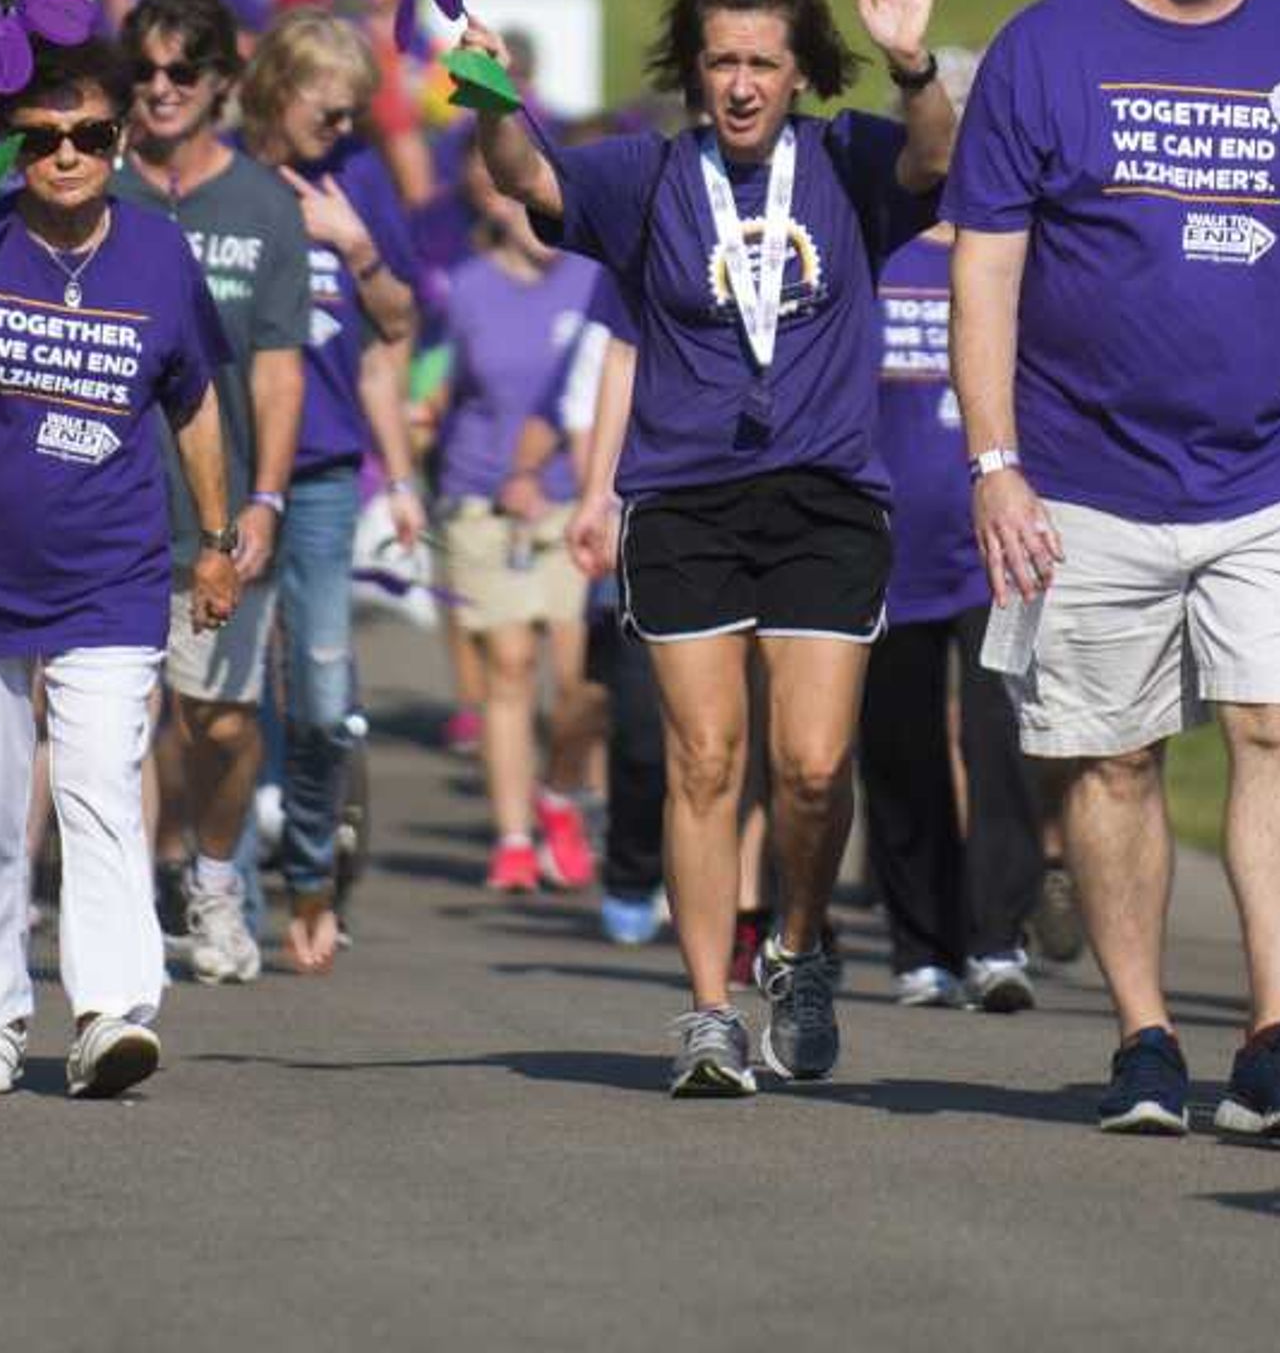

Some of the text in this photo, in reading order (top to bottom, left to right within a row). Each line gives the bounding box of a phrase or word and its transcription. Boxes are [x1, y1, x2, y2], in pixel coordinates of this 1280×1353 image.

[1110, 98, 1278, 134] TOGETHER,
[1113, 131, 1275, 161] WE CAN END
[1114, 160, 1275, 192] ALZHEIMER'S.
[1187, 213, 1226, 226] WALK
[1187, 227, 1244, 243] END
[32, 344, 82, 370] CAN
[88, 352, 138, 377] END
